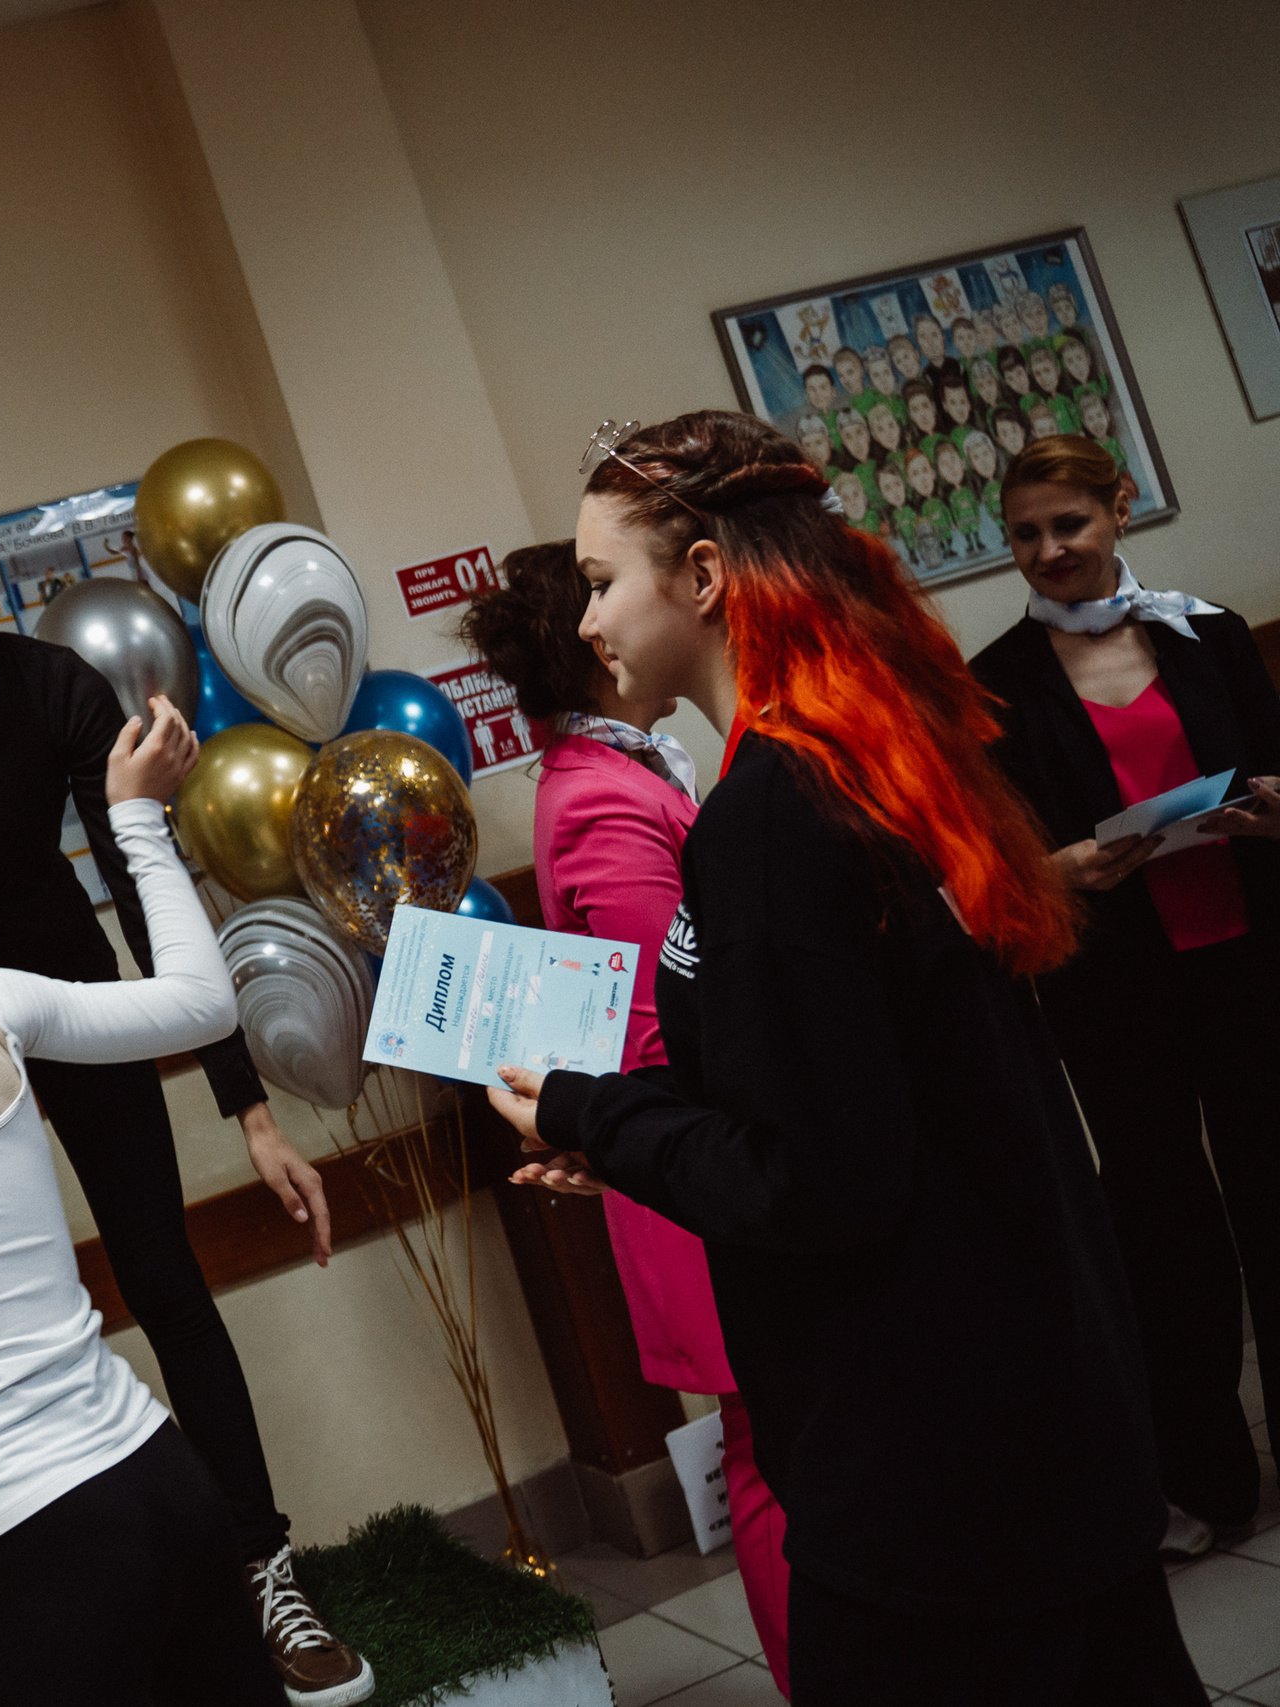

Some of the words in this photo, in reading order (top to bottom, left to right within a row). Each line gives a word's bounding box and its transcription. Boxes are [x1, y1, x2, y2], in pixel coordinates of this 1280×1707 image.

[408, 576, 451, 595] ПОЖАРЕ
[414, 566, 436, 580] ПРИ
[454, 551, 495, 592] 01
[410, 589, 458, 609] ЗВОНИТЬ
[425, 953, 455, 1033] Диплом
[451, 964, 470, 1027] Награждается
[486, 975, 497, 1001] место
[488, 1014, 502, 1060] программе
[499, 997, 516, 1051] результатом
